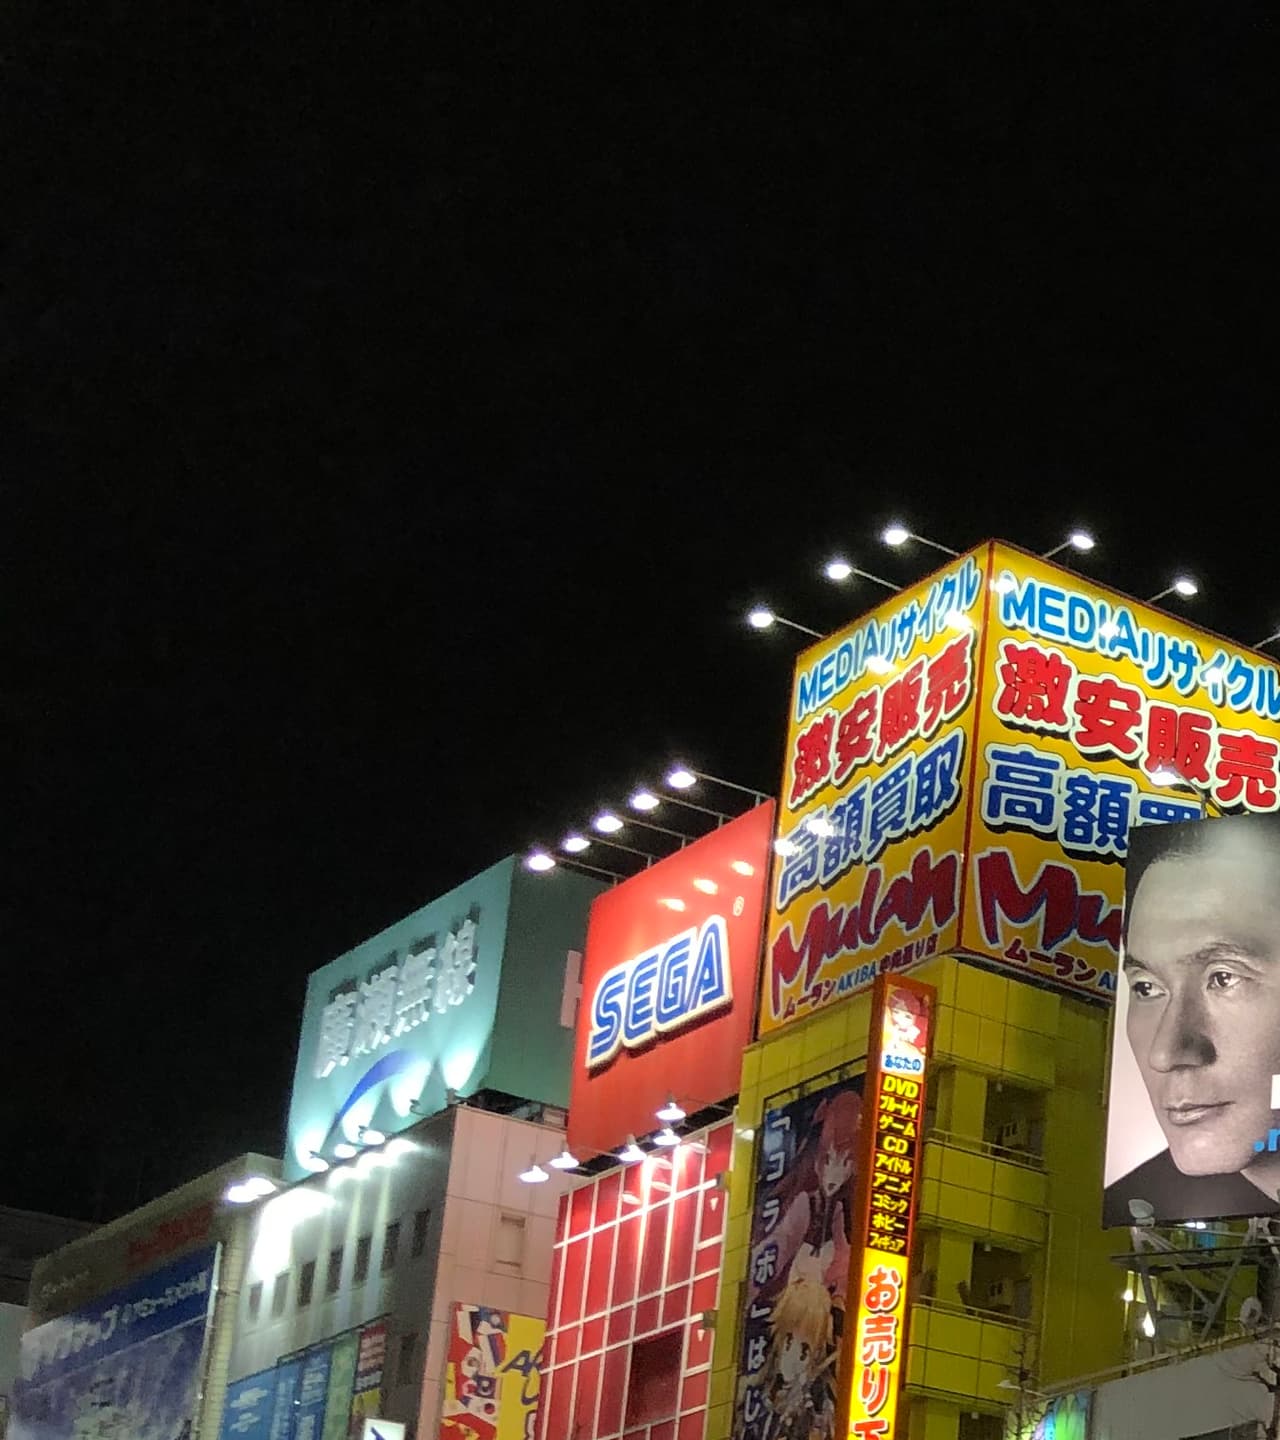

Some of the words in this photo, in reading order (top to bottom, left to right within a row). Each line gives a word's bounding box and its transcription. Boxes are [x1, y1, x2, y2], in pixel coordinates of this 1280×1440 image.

[797, 556, 980, 719] MEDIAリサイクル
[788, 634, 975, 806] 激安販売
[984, 744, 1202, 853] 高額
[777, 728, 964, 906] 高額買取
[770, 848, 960, 1002] Mulan
[1004, 938, 1098, 984] ムーラン
[588, 913, 733, 1072] SEGA
[884, 1054, 922, 1072] あなたの
[883, 1076, 919, 1098] DVD
[878, 1115, 917, 1138] ゲーム
[883, 1135, 909, 1155] CD
[875, 1153, 913, 1175] アイドル
[874, 1174, 911, 1195] アニメ
[873, 1193, 909, 1214] コミック
[871, 1213, 906, 1233] ホビー
